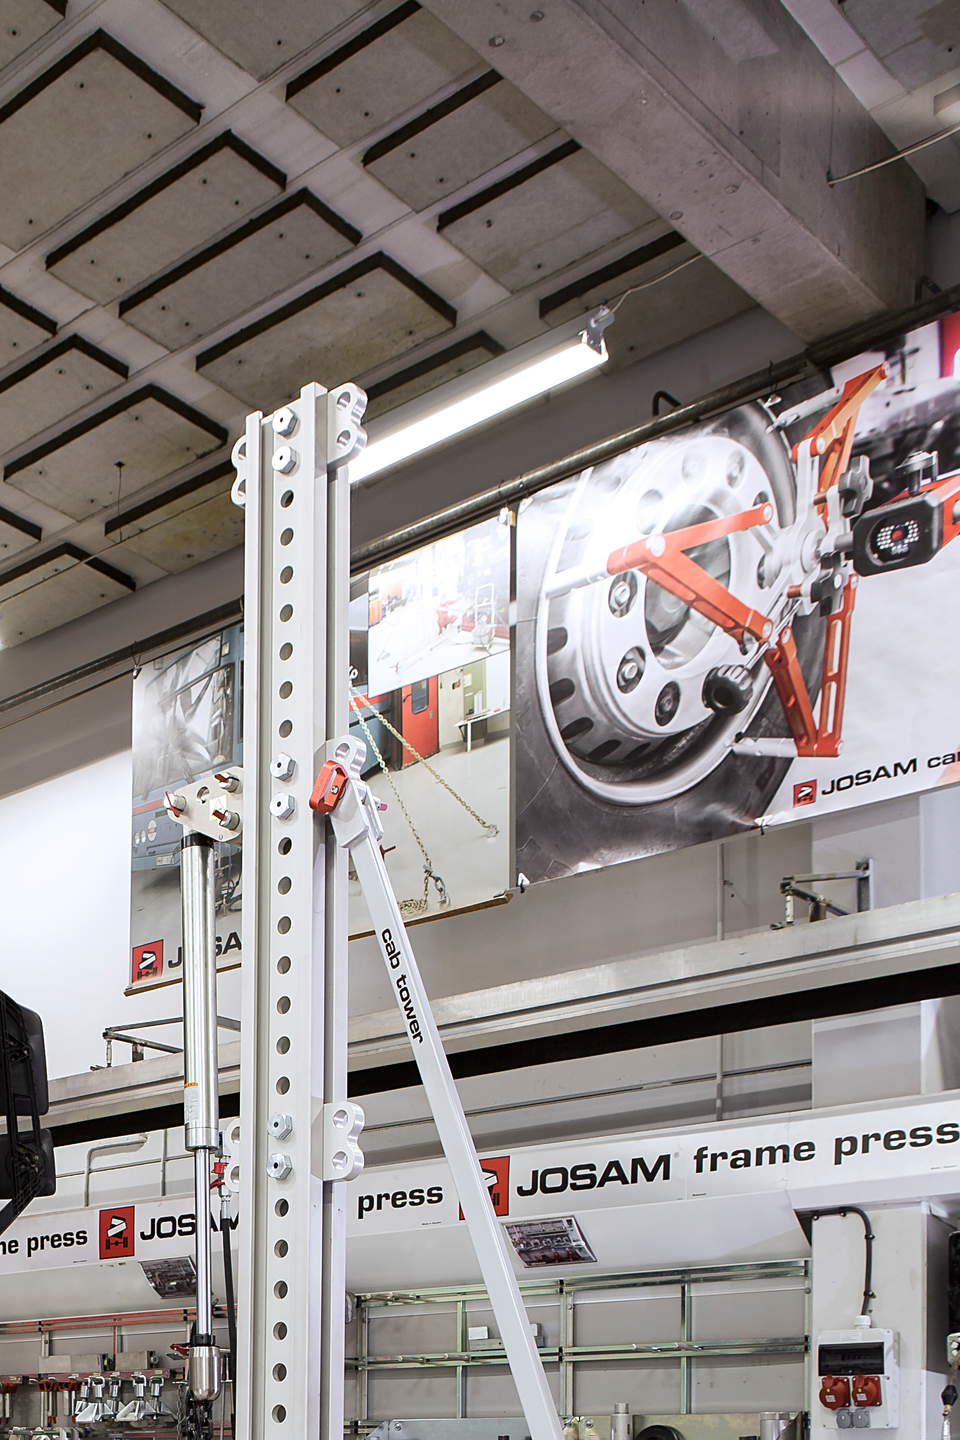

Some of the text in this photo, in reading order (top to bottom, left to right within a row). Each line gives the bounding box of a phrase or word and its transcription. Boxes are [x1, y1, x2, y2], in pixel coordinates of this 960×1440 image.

[821, 757, 917, 795] JOSAM
[381, 928, 423, 1044] cab tower
[516, 1122, 960, 1197] JOSAM frame press
[357, 1185, 444, 1220] press
[27, 1229, 88, 1257] press
